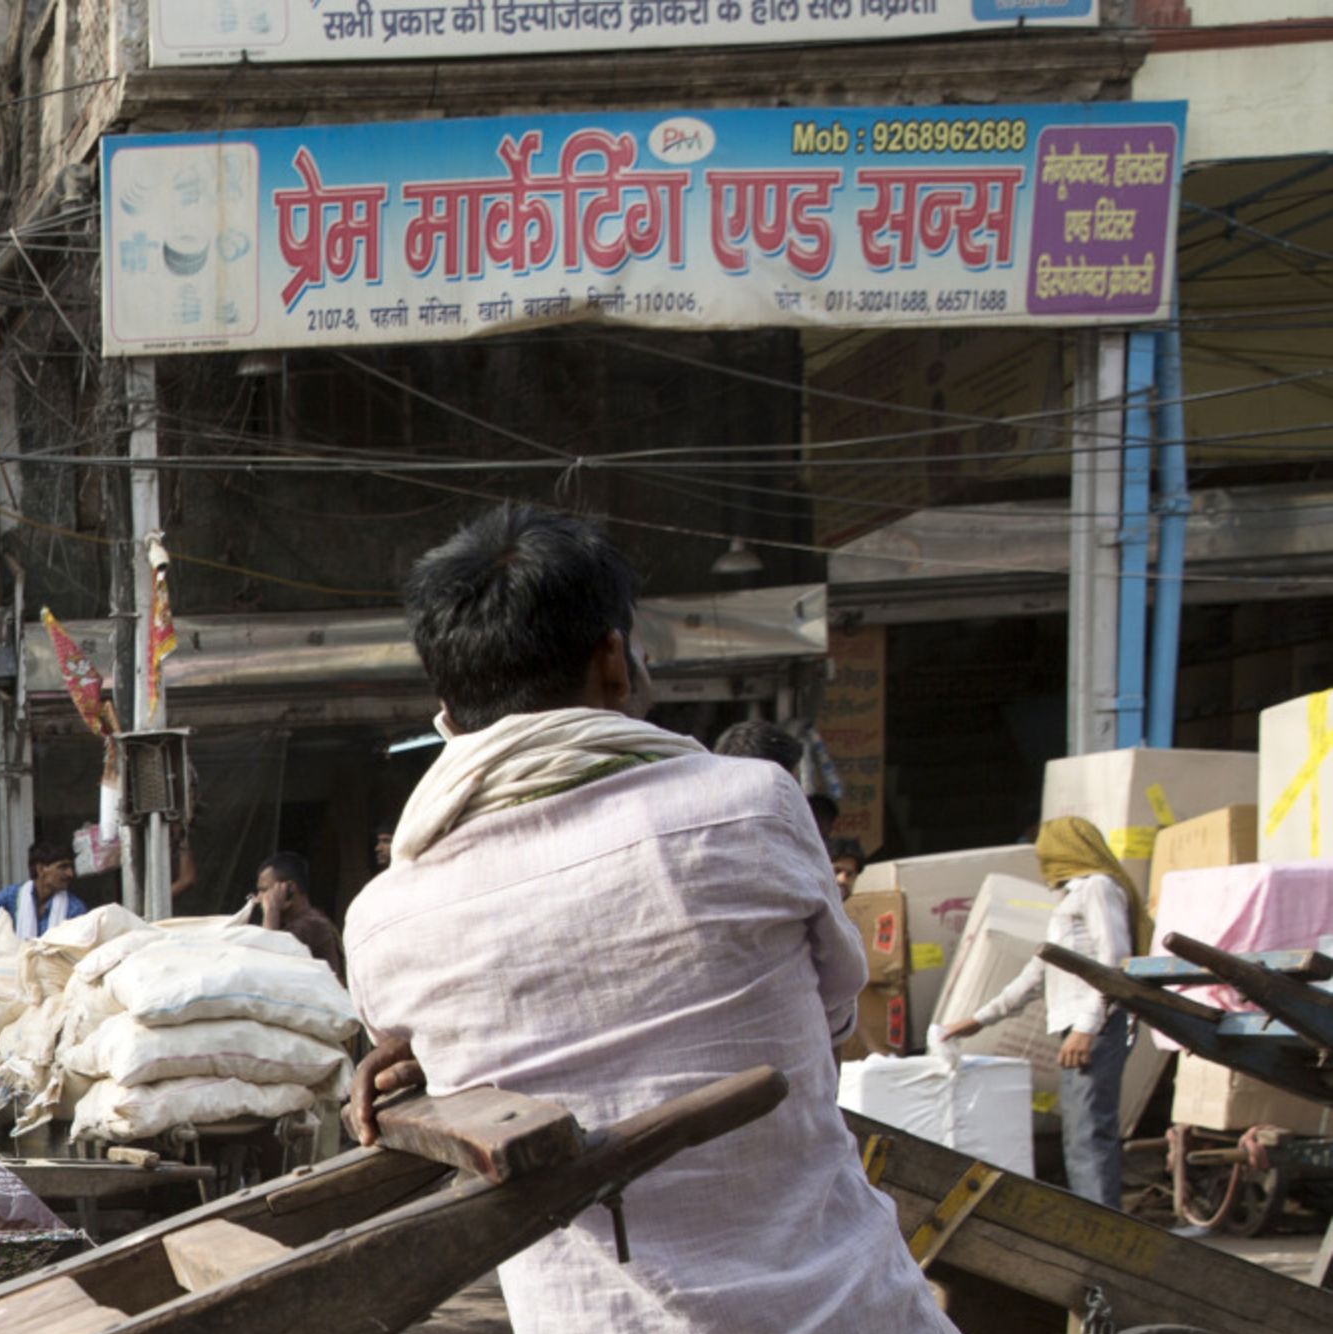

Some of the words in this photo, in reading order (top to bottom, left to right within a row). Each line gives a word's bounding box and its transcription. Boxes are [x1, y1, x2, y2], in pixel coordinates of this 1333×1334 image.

[381, 7, 448, 43] प्रकार
[793, 123, 849, 154] Mob
[872, 120, 1028, 154] 9268962688
[273, 145, 388, 308] प्रेम
[402, 129, 691, 276] मार्केटिंग
[705, 168, 842, 279] एण्ड
[857, 168, 1026, 272] सन्स
[307, 309, 359, 332] 2107-8,
[370, 299, 409, 328] पहली
[477, 293, 513, 322] खारी
